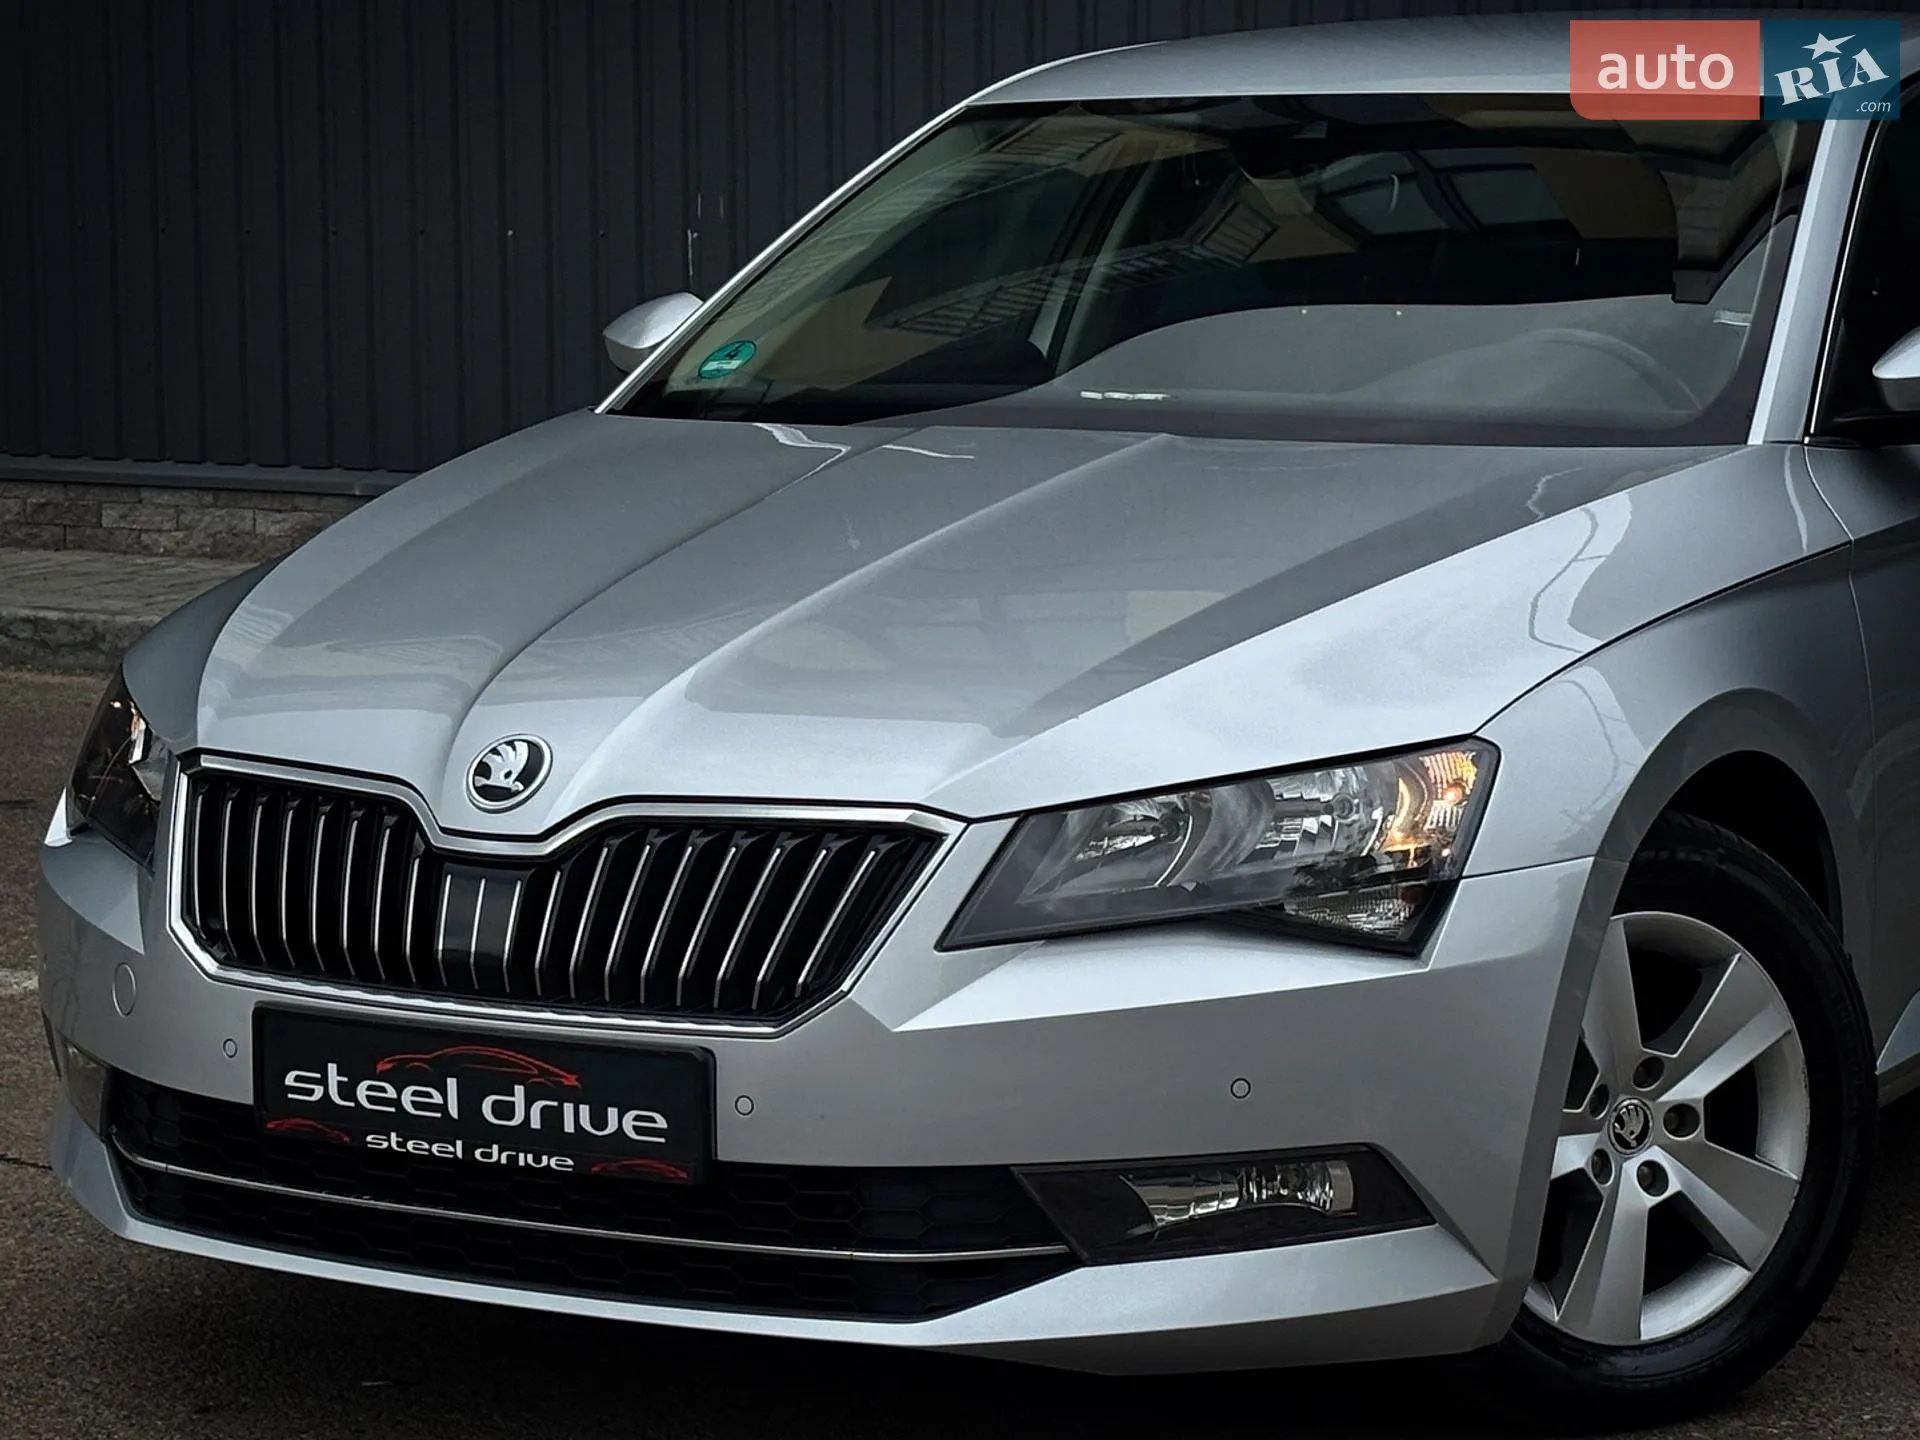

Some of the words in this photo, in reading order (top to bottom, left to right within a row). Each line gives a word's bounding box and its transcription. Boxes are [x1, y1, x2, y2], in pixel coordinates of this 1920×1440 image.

[284, 1062, 459, 1121] steel
[481, 1084, 668, 1143] drive
[366, 1132, 463, 1160] steel
[474, 1145, 575, 1172] drive
